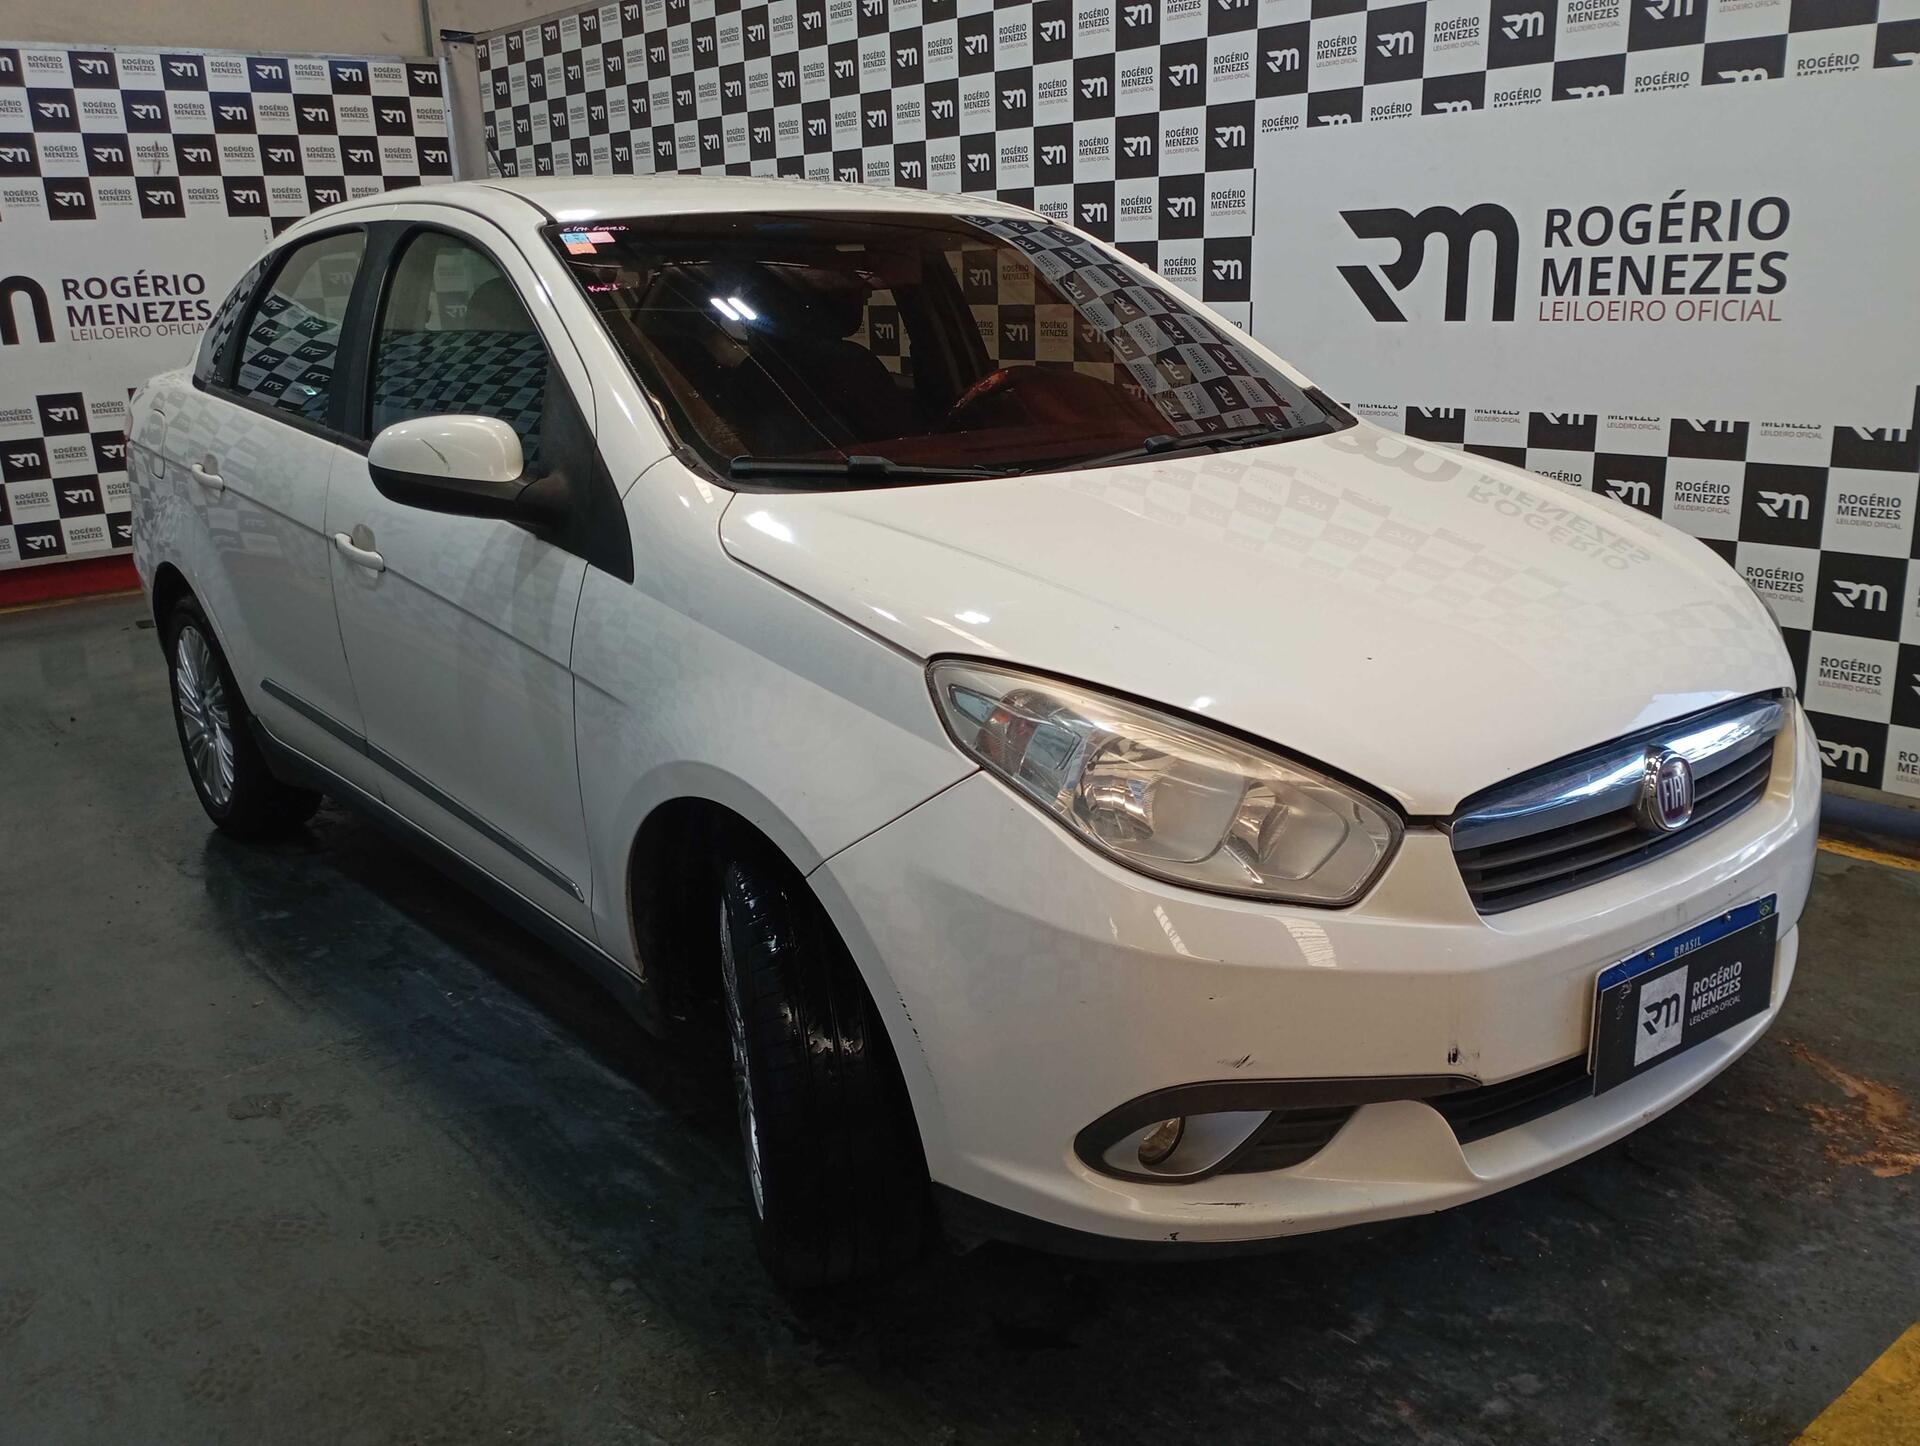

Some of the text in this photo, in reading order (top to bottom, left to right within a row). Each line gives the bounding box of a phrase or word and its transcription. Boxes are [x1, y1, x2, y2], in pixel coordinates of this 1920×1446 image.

[1078, 7, 1109, 20] ROGÉRIO
[1567, 7, 1619, 24] MENEZES
[999, 23, 1026, 35] ROGÉRIO
[1078, 16, 1109, 29] MENEZES
[1434, 16, 1479, 32] ROGÉRIO
[999, 31, 1026, 43] MENEZES
[1433, 27, 1479, 42] MENEZES
[1317, 35, 1356, 49] ROGÉRIO
[1213, 51, 1248, 64] ROGÉRIO
[1316, 45, 1356, 59] MENEZES
[1213, 61, 1248, 74] MENEZES
[1797, 53, 1860, 70] ROGÉRIO
[1121, 66, 1152, 78] ROGÉRIO
[1038, 79, 1066, 90] ROGÉRIO
[1121, 75, 1153, 87] MENEZES
[1635, 71, 1690, 87] ROGÉRIO
[964, 90, 989, 101] ROGÉRIO
[1038, 88, 1067, 99] MENEZES
[1493, 87, 1542, 102] ROGÉRIO
[964, 99, 989, 109] MENEZES
[1370, 103, 1412, 116] ROGÉRIO
[1262, 115, 1299, 128] ROGÉRIO
[1165, 126, 1198, 138] ROGÉRIO
[1079, 136, 1108, 147] ROGÉRIO
[1165, 136, 1198, 147] MENEZES
[1001, 145, 1027, 155] ROGÉRIO
[1079, 145, 1108, 155] MENEZES
[1001, 154, 1028, 163] MENEZES
[1211, 188, 1245, 199] ROGÉRIO
[1121, 195, 1151, 206] ROGÉRIO
[1211, 199, 1245, 209] MENEZES
[1121, 205, 1152, 214] MENEZES
[1544, 188, 1790, 249] ROGÉRIO
[1164, 256, 1196, 266] ROGÉRIO
[1163, 266, 1196, 275] MENEZES
[1540, 250, 1789, 297] MENEZES
[61, 269, 206, 301] ROGÉRIO
[66, 300, 212, 327] MENEZES
[1539, 299, 1782, 322] LEILOEIRO OFICIAL
[71, 322, 208, 341] LEILOEIRO OFICIA
[1675, 480, 1730, 494] ROGÉRIO
[1674, 492, 1729, 505] MENEZES
[1838, 493, 1901, 507] ROGÉRIO
[1837, 505, 1900, 519] MENEZES
[1746, 566, 1804, 582] ROGÉRIO
[1820, 656, 1881, 674] ROGÉRIO
[1819, 667, 1881, 685] MENEZES
[1662, 773, 1687, 812] FIAT
[1673, 936, 1702, 957] BRASIL
[1692, 961, 1742, 996] ROGÉRIO
[1690, 976, 1742, 1013] MENEZES
